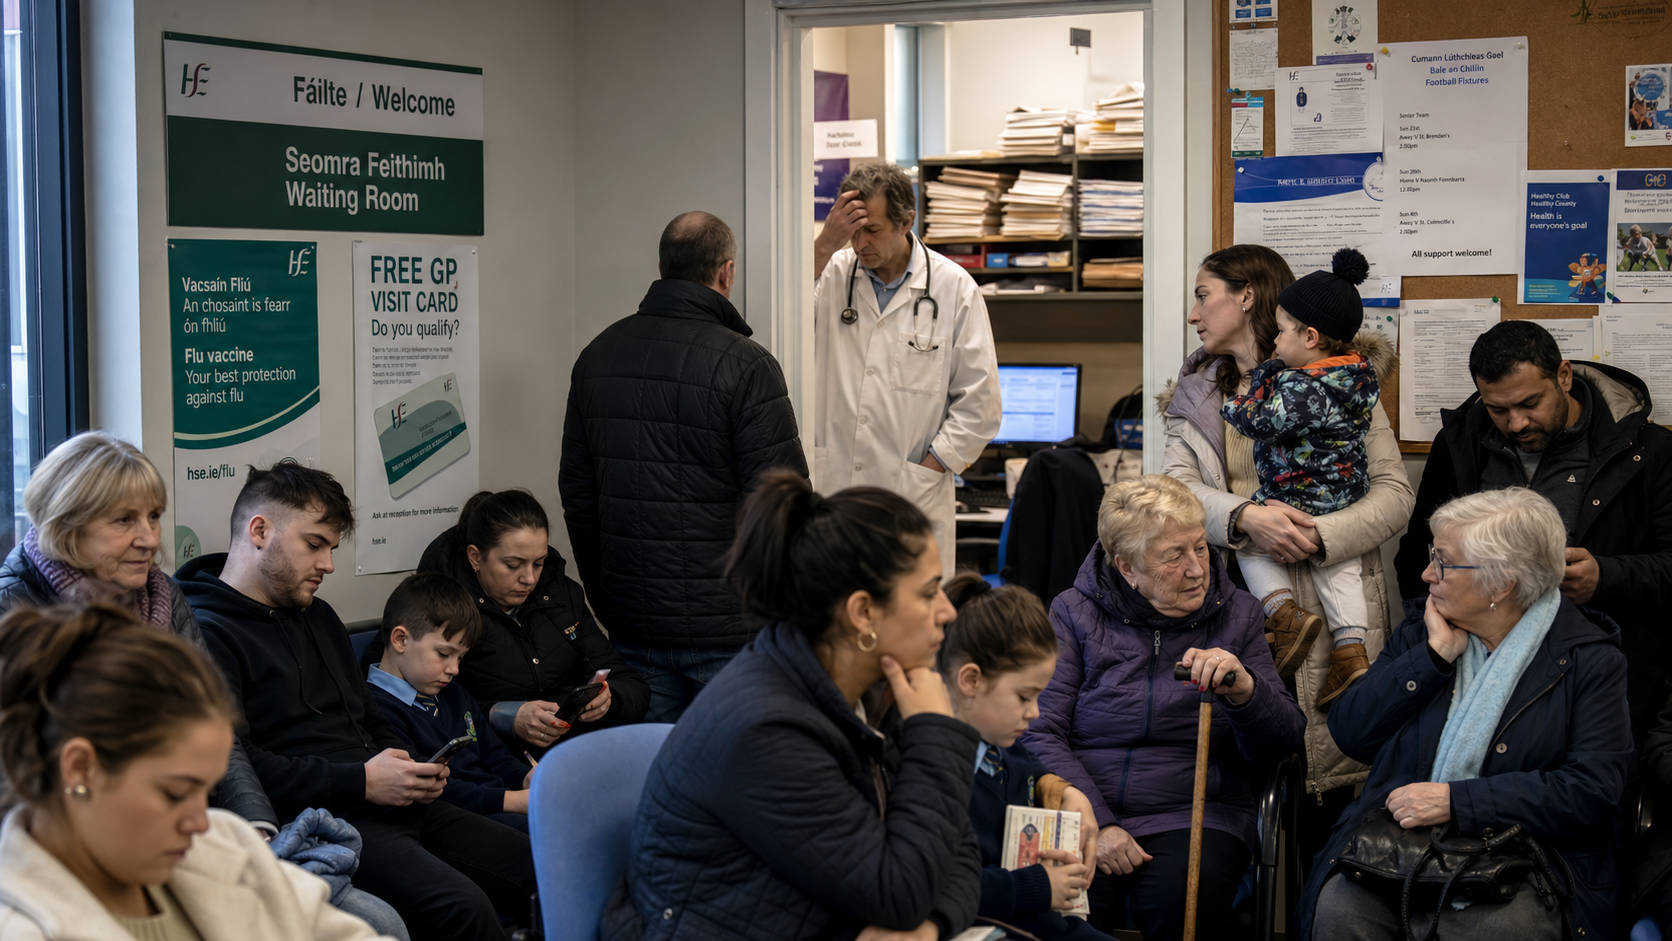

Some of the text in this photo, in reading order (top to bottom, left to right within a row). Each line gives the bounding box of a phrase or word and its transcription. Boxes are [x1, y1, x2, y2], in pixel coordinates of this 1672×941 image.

[1411, 55, 1442, 63] Cumann
[1486, 51, 1504, 59] Gael
[180, 62, 211, 98] HSE
[1425, 77, 1489, 86] Football Fixtures
[293, 75, 455, 117] Fáilte / Welcome
[285, 146, 445, 181] Seomra Feithimh
[285, 181, 419, 215] Waiting Room
[1530, 212, 1562, 220] Health is
[1530, 222, 1587, 230] everyone's goal
[1412, 249, 1492, 259] All support welcome!
[288, 248, 311, 277] HSE
[371, 255, 458, 285] FREE GP
[182, 277, 251, 292] Vacsaín Fliú
[183, 297, 291, 313] An chosaint is fearr
[371, 291, 458, 312] VISIT CARD
[184, 317, 226, 333] ón fhliú
[372, 319, 460, 340] Do you qualify?
[185, 347, 254, 363] Flu vaccine
[186, 366, 296, 385] Your best protection
[186, 387, 243, 409] against flu
[187, 464, 235, 480] hse.ie/flu
[389, 509, 411, 519] reception
[432, 506, 459, 514] information
[372, 536, 386, 545] hse.ie
